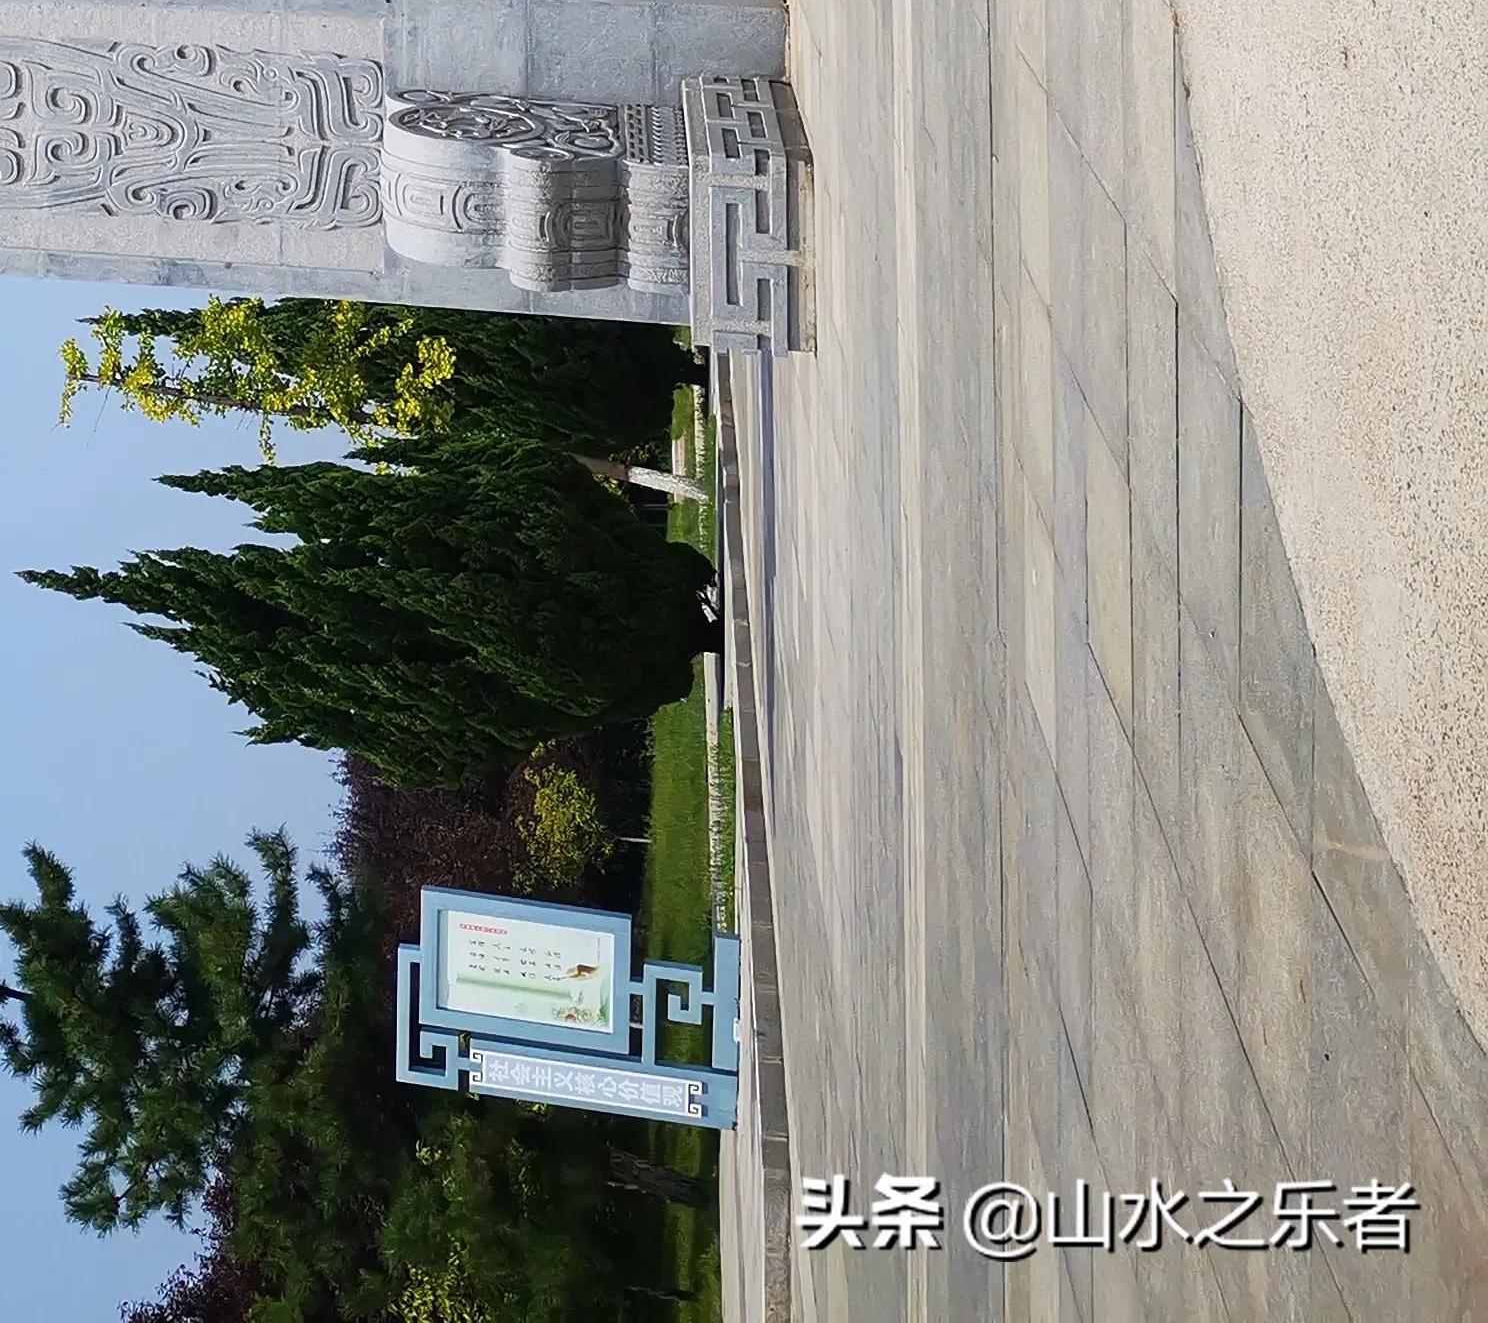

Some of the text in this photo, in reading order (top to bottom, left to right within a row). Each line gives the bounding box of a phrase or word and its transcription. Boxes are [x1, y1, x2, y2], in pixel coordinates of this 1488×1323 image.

[489, 1058, 684, 1108] 社会主义核心价值观
